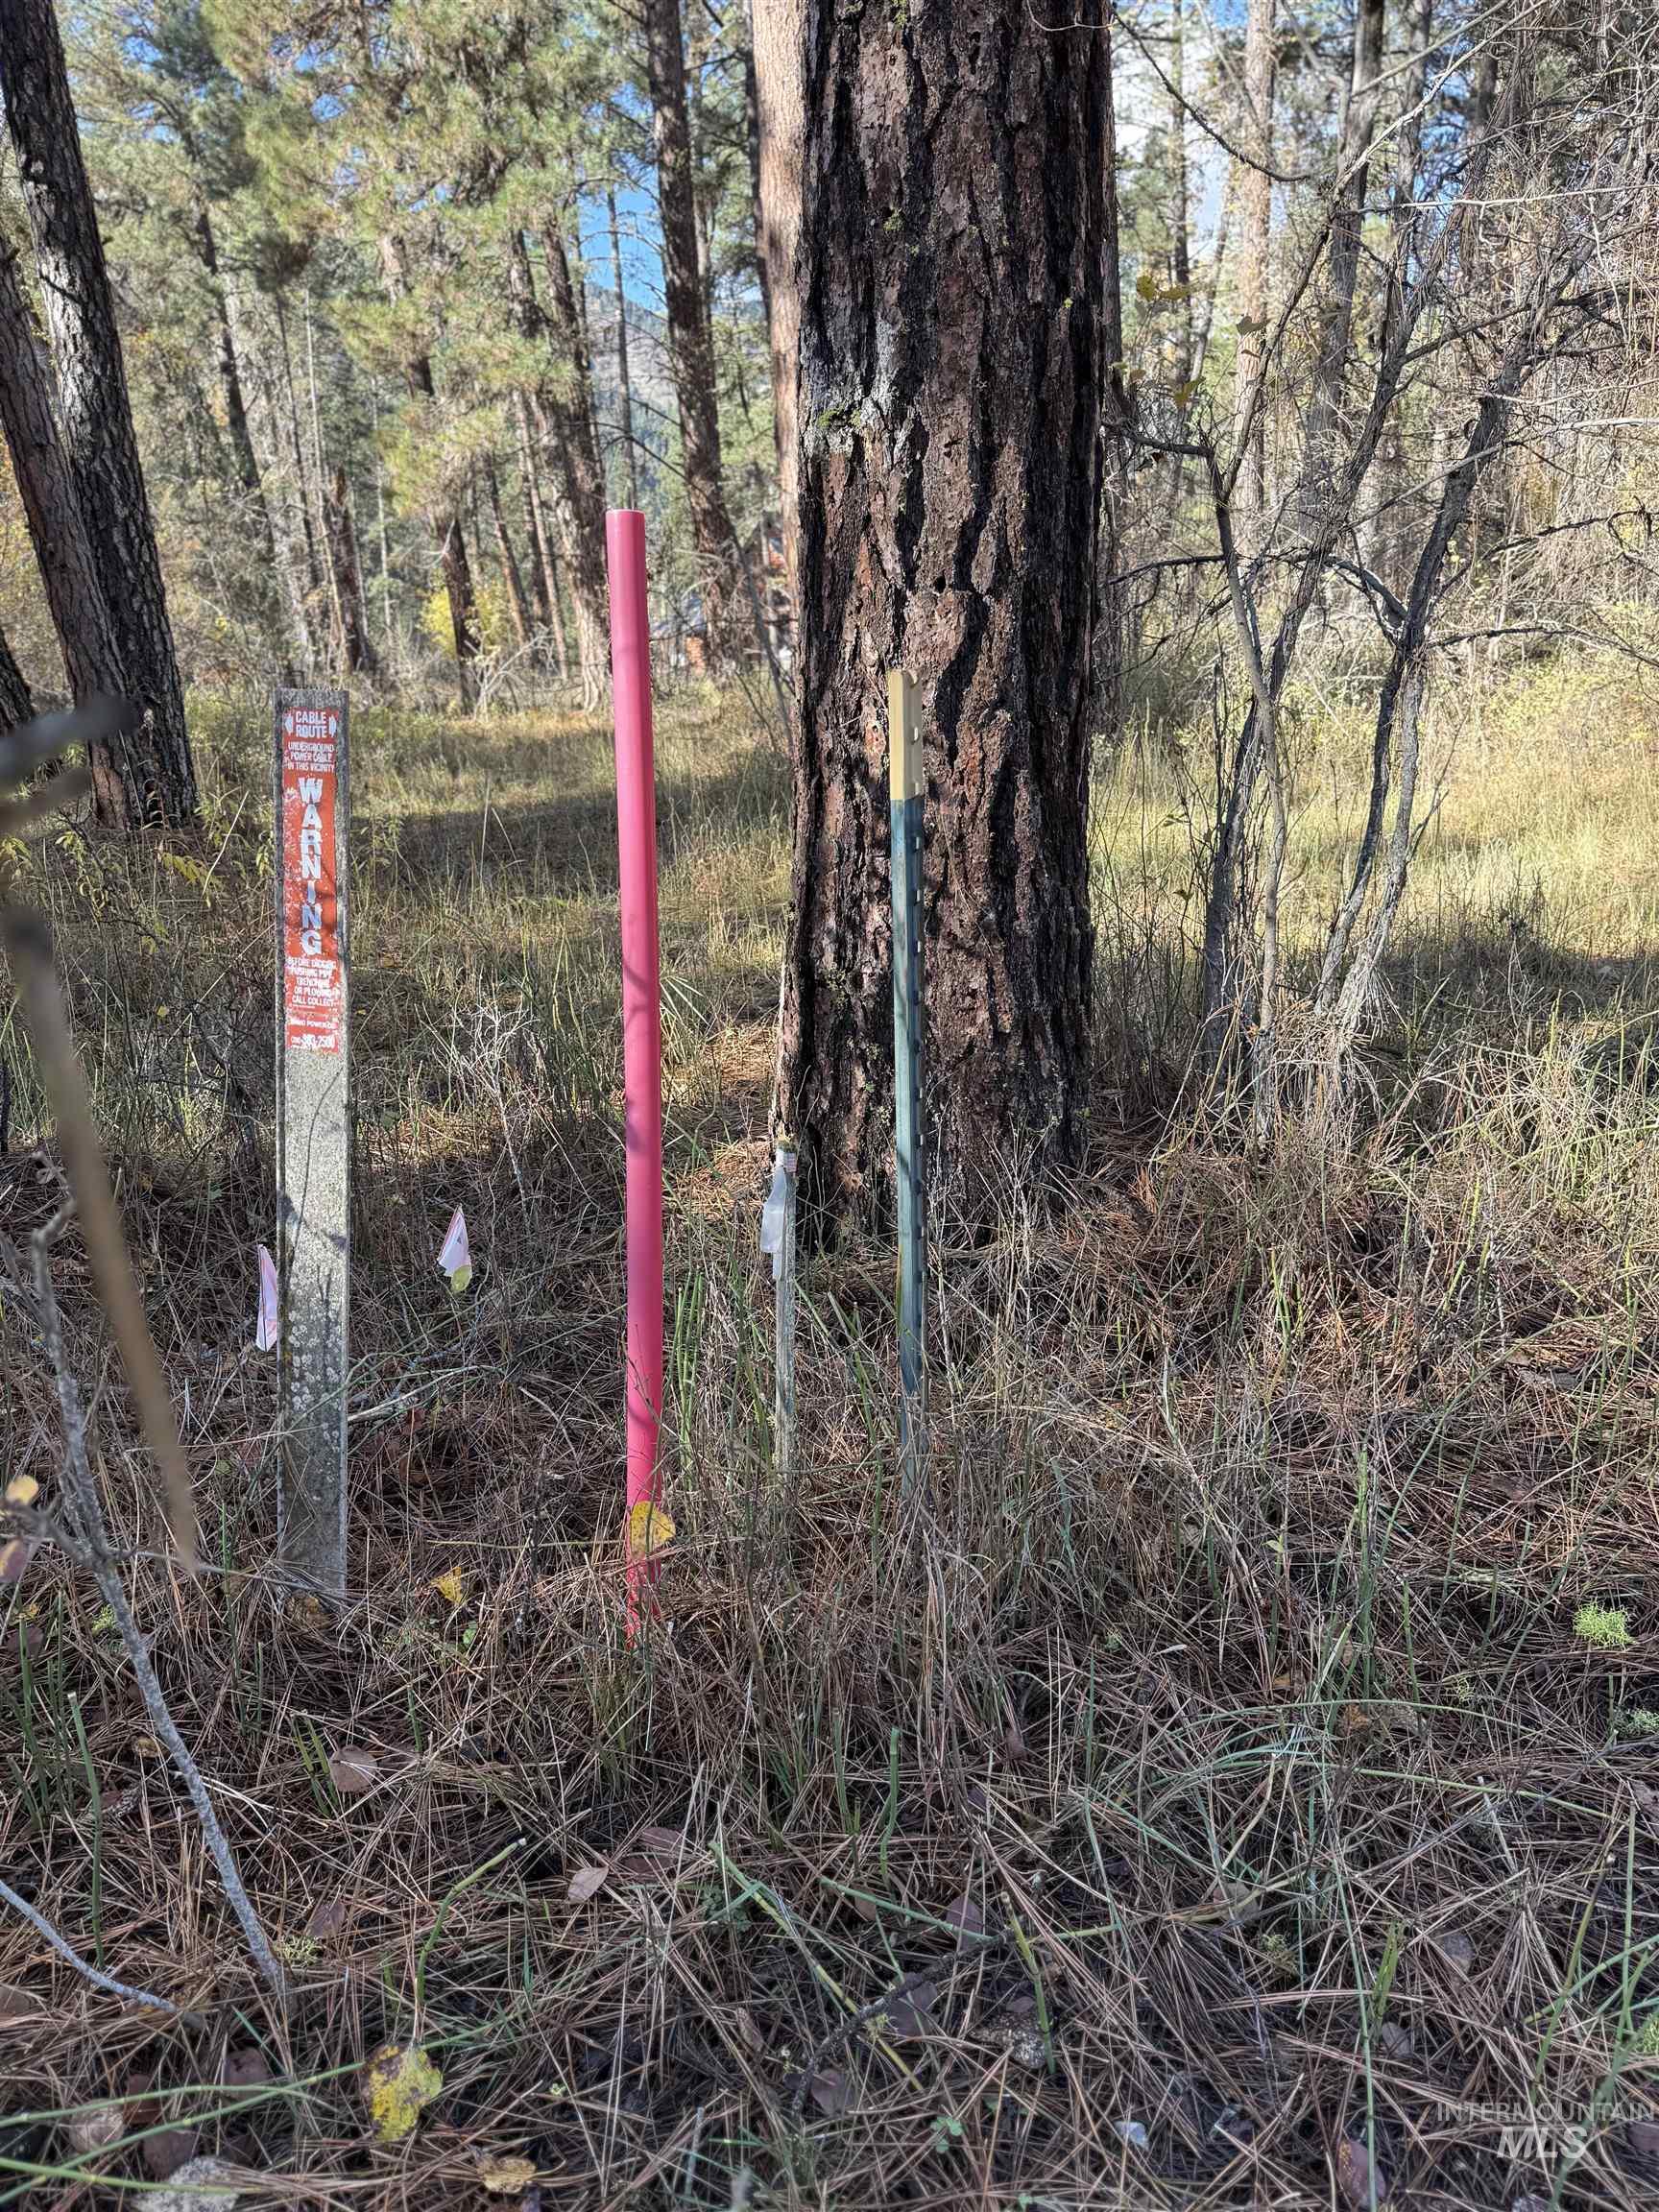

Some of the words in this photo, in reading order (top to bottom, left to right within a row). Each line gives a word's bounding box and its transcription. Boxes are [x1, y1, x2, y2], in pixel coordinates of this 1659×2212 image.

[295, 710, 326, 724] CABLE
[295, 725, 327, 738] ROUTE
[287, 741, 334, 753] UNDERGROUND
[291, 751, 312, 761] POWER
[296, 762, 309, 772] THIS
[299, 778, 323, 955] WARNING
[292, 995, 307, 1005] CALL
[308, 997, 334, 1007] COLLECT
